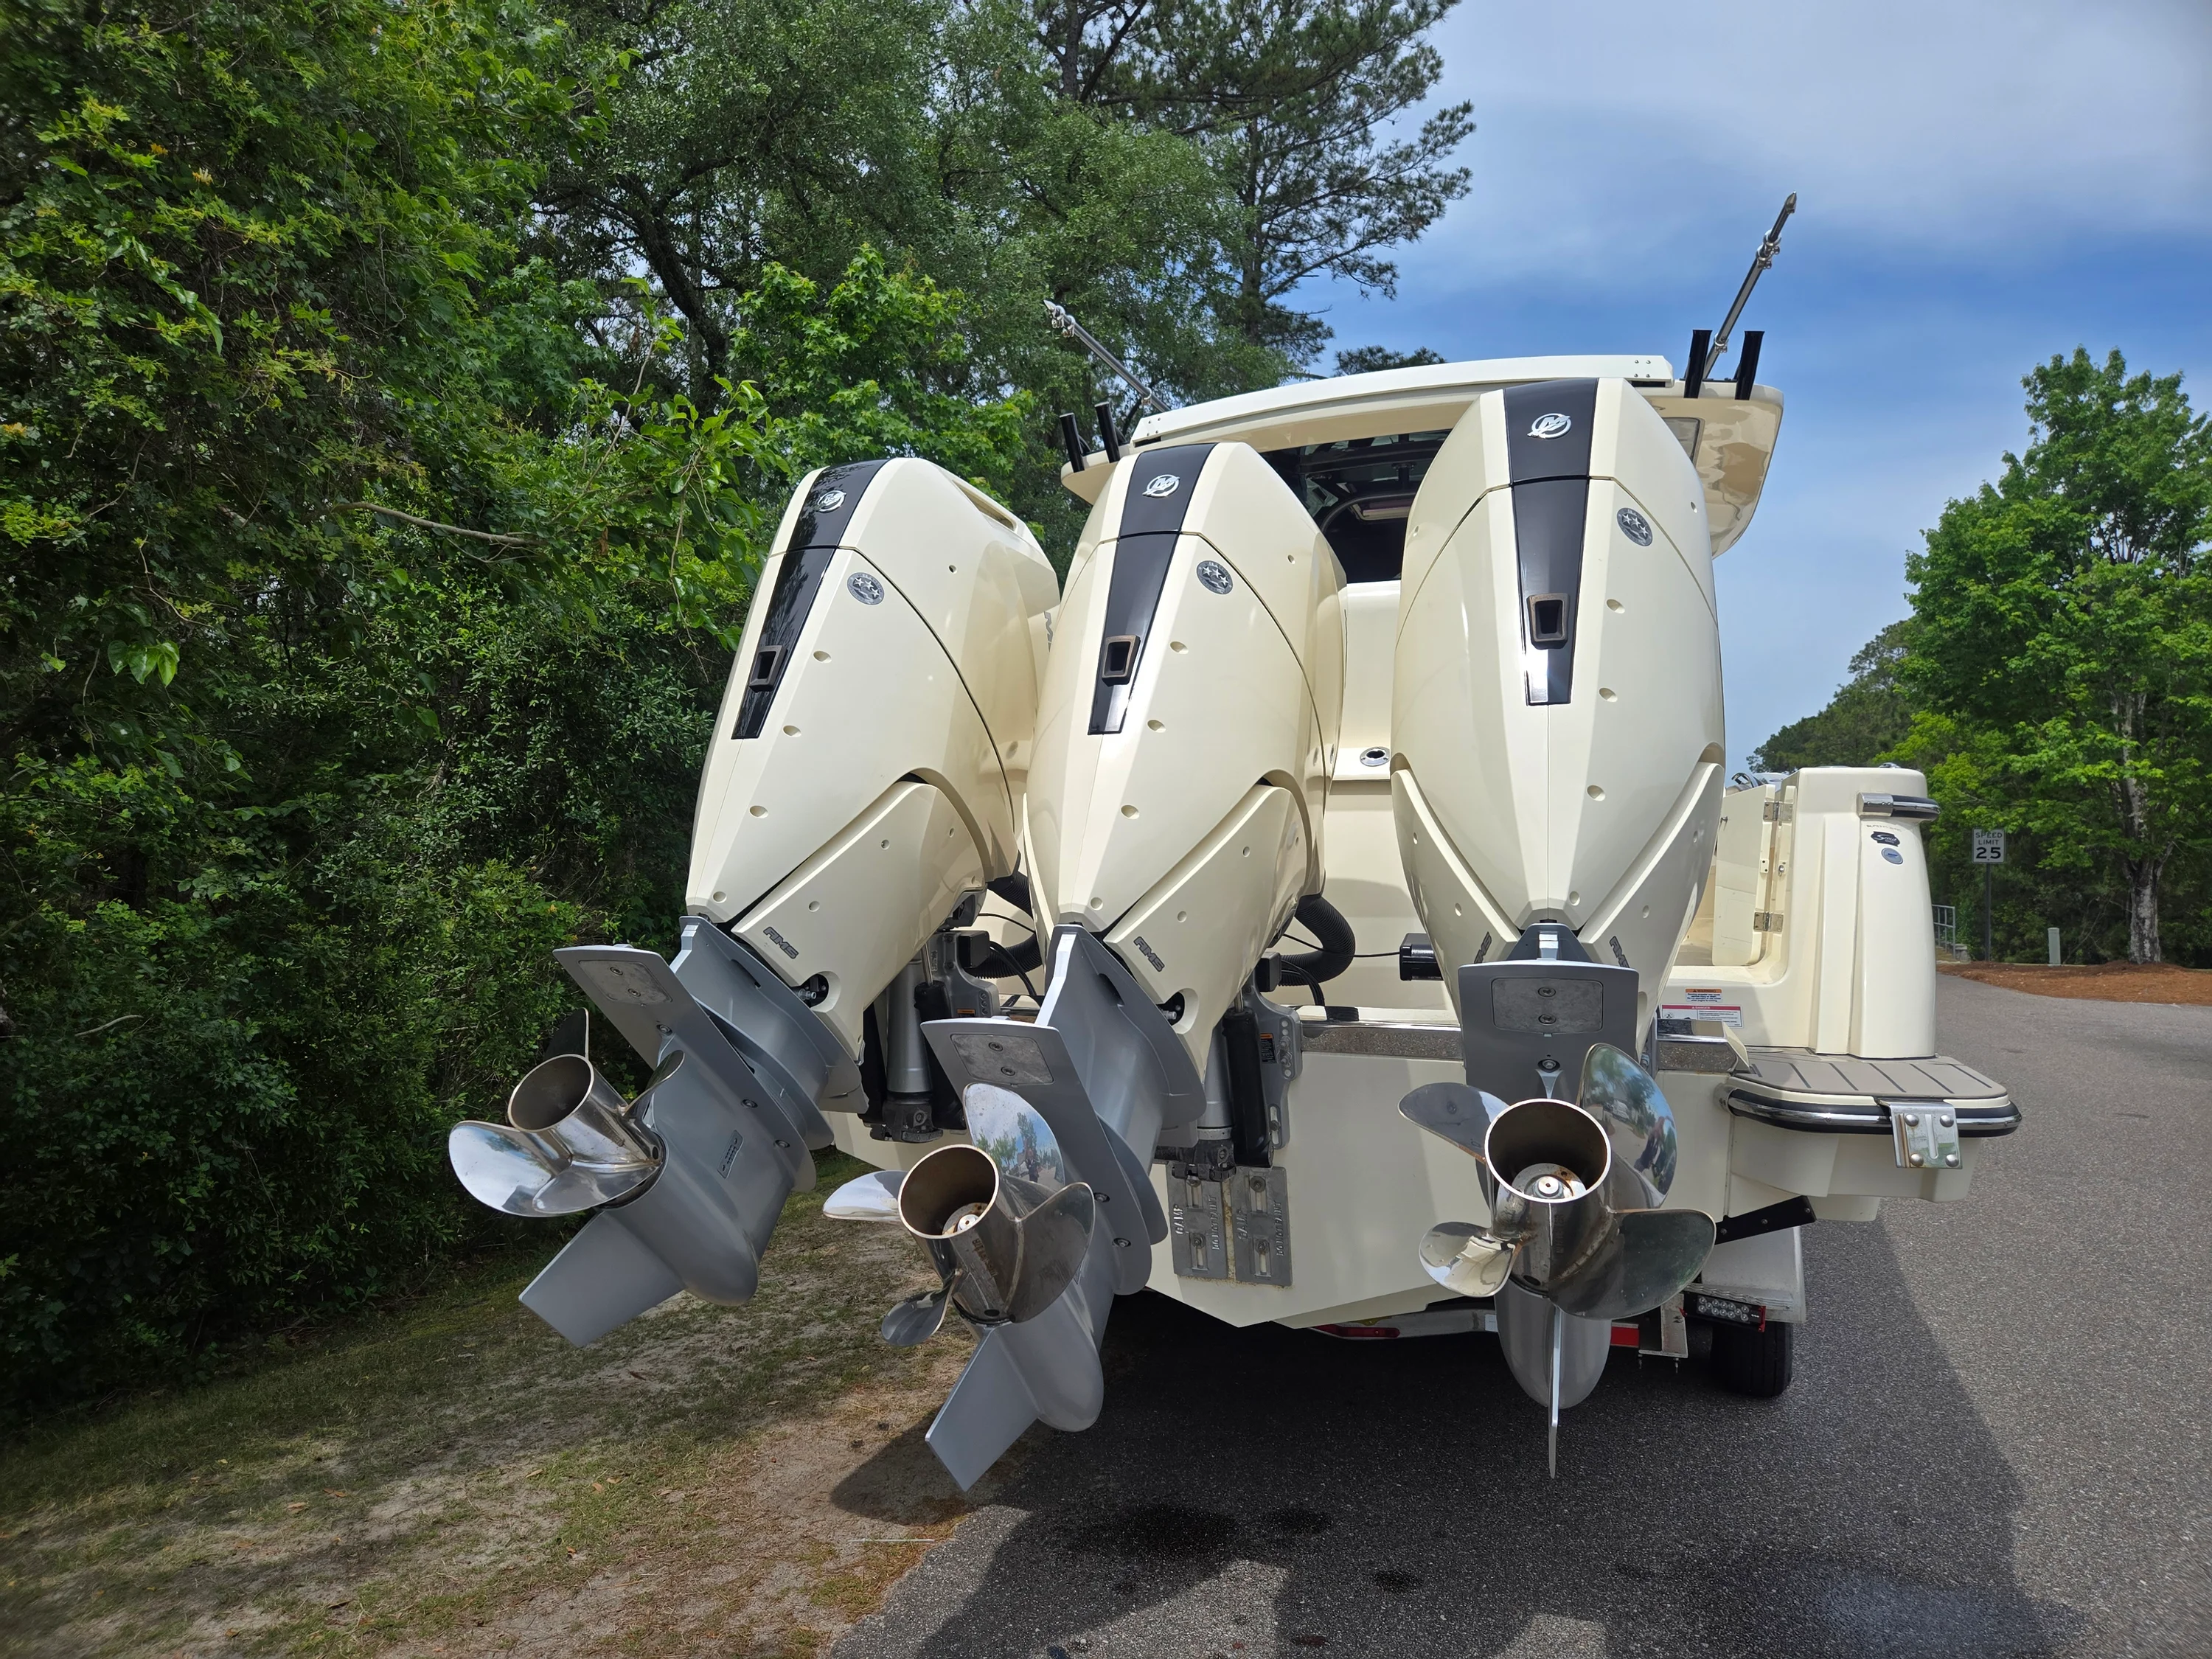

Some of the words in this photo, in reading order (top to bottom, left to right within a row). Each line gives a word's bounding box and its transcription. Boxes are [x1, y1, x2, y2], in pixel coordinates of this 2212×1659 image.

[1975, 846, 2001, 859] 25
[763, 926, 799, 959] AMS
[1133, 936, 1165, 972] AMS
